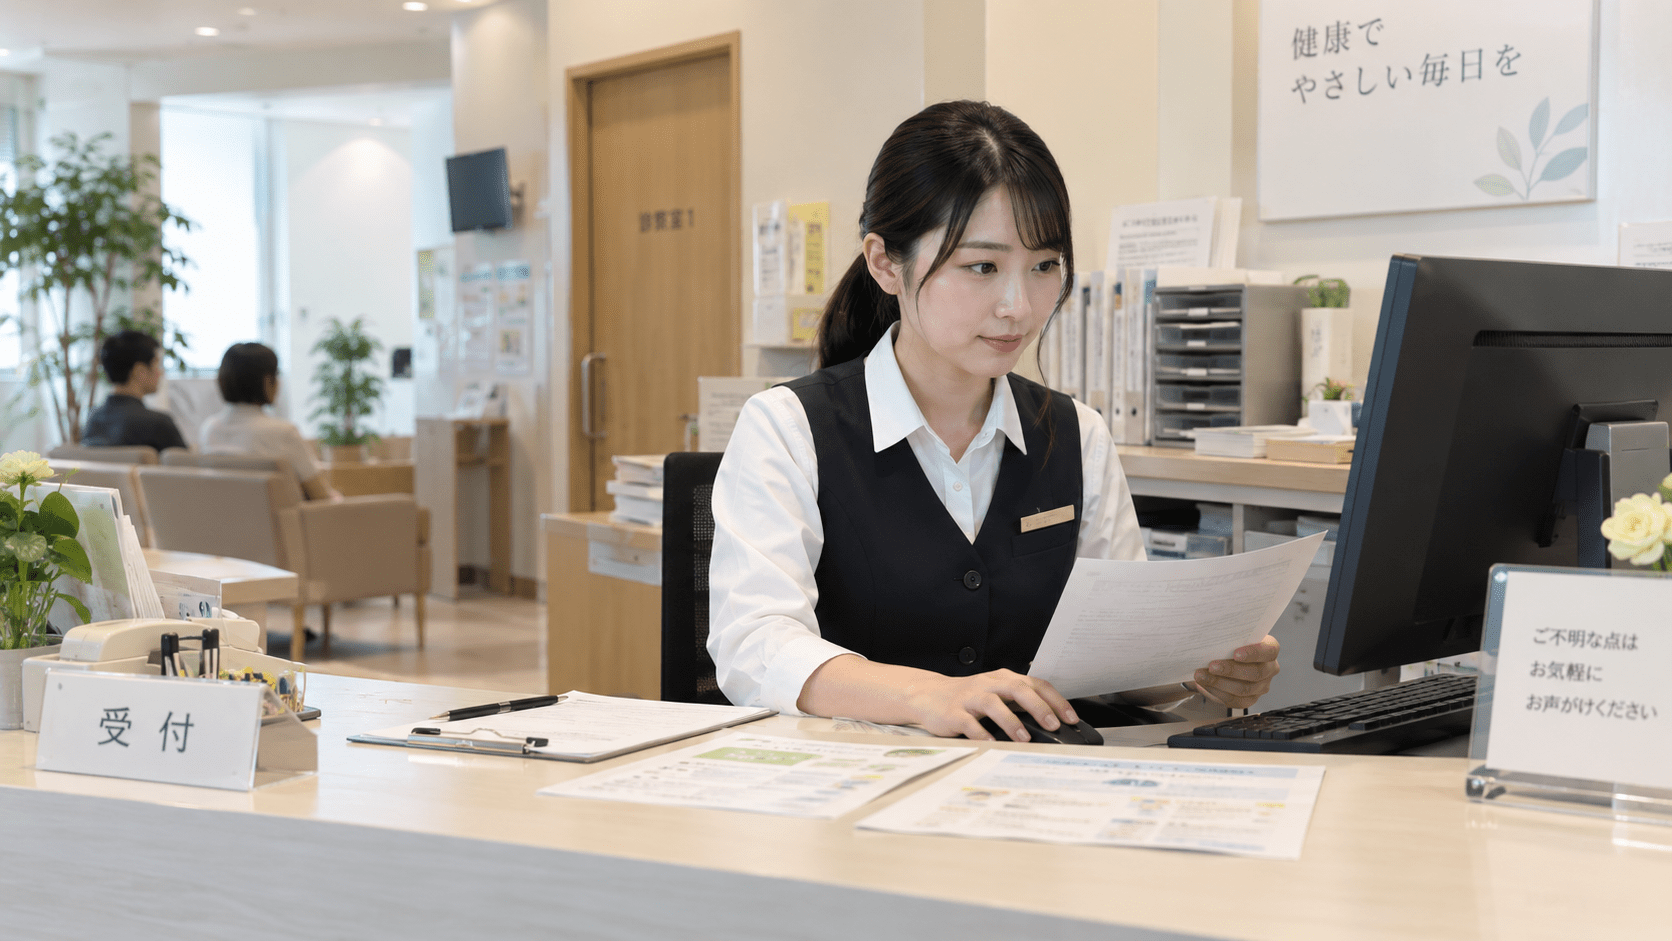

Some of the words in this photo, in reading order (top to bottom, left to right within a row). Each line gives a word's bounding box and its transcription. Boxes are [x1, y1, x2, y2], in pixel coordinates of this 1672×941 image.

[1292, 18, 1384, 61] 健康で
[1291, 44, 1521, 104] やさしい毎日を
[1533, 627, 1639, 651] ご不明な点は
[1530, 661, 1604, 683] お気軽に
[1526, 694, 1658, 721] お声がけください
[98, 706, 194, 753] 受付
